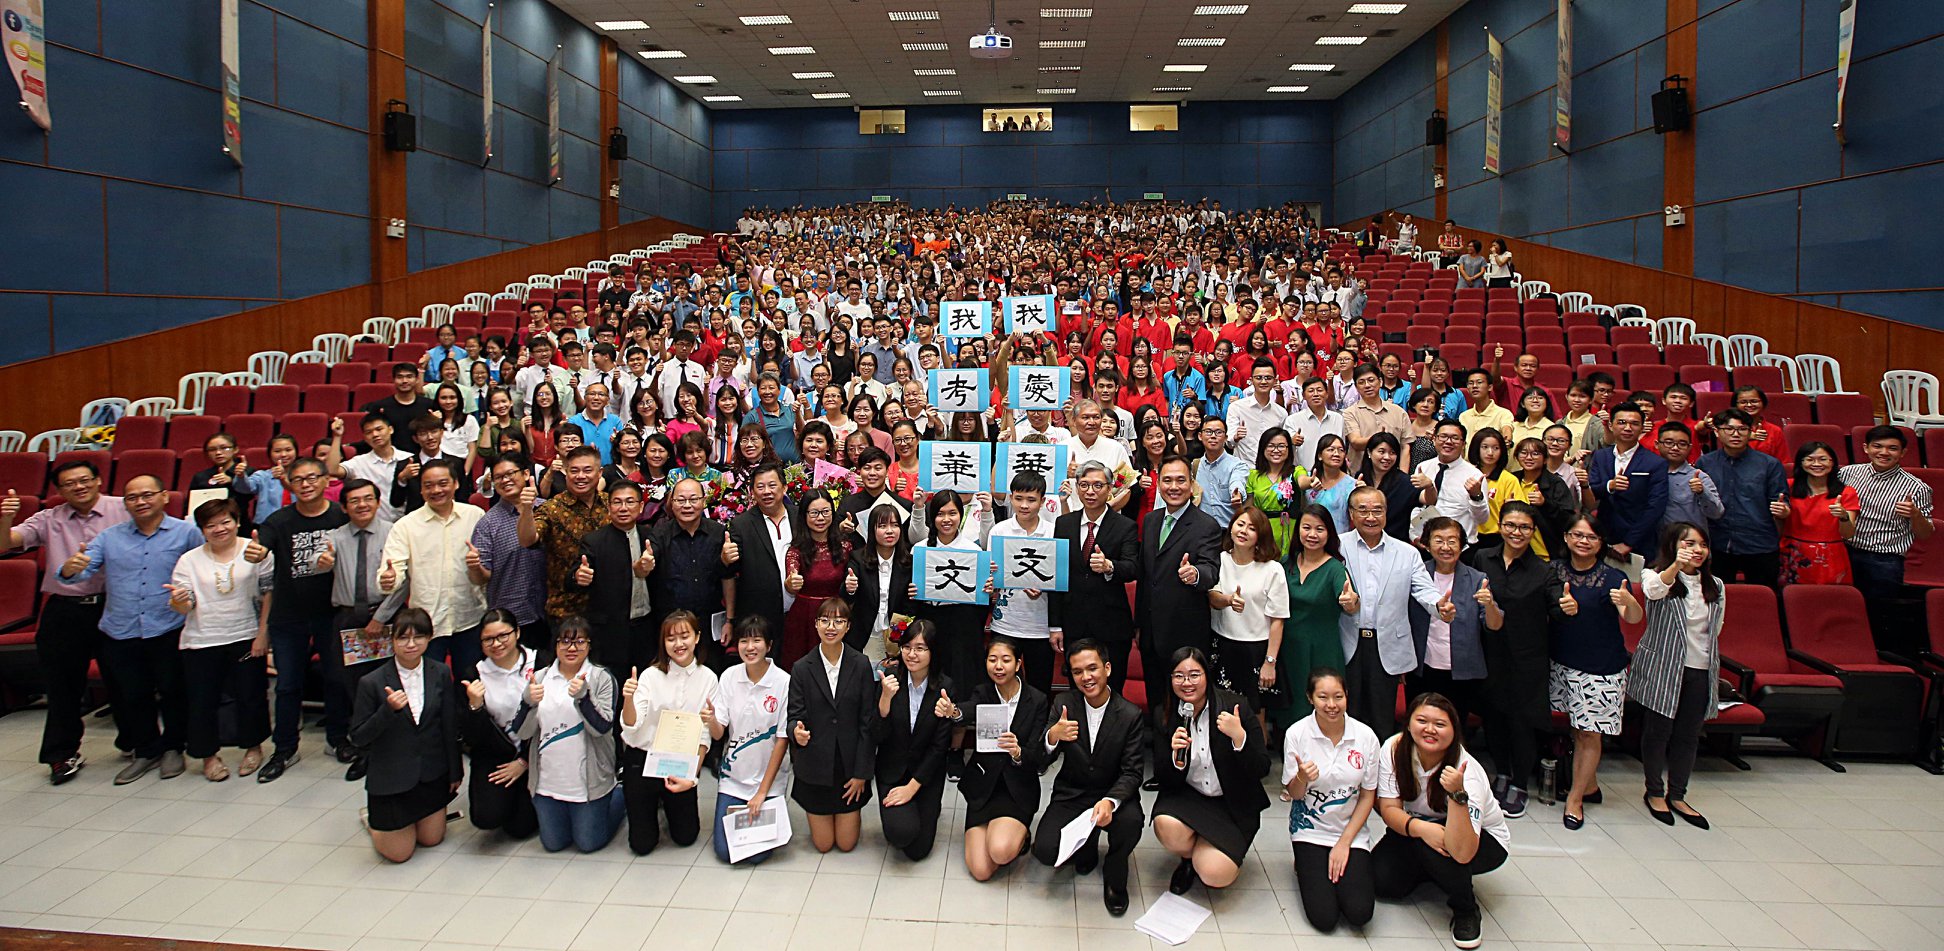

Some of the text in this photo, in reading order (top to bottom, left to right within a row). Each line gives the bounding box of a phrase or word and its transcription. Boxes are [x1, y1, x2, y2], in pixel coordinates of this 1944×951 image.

[950, 308, 980, 331] 我
[1015, 303, 1047, 326] 我
[940, 373, 977, 407] 考
[934, 450, 977, 486] 華
[934, 558, 977, 594] 文
[1011, 548, 1054, 583] 文
